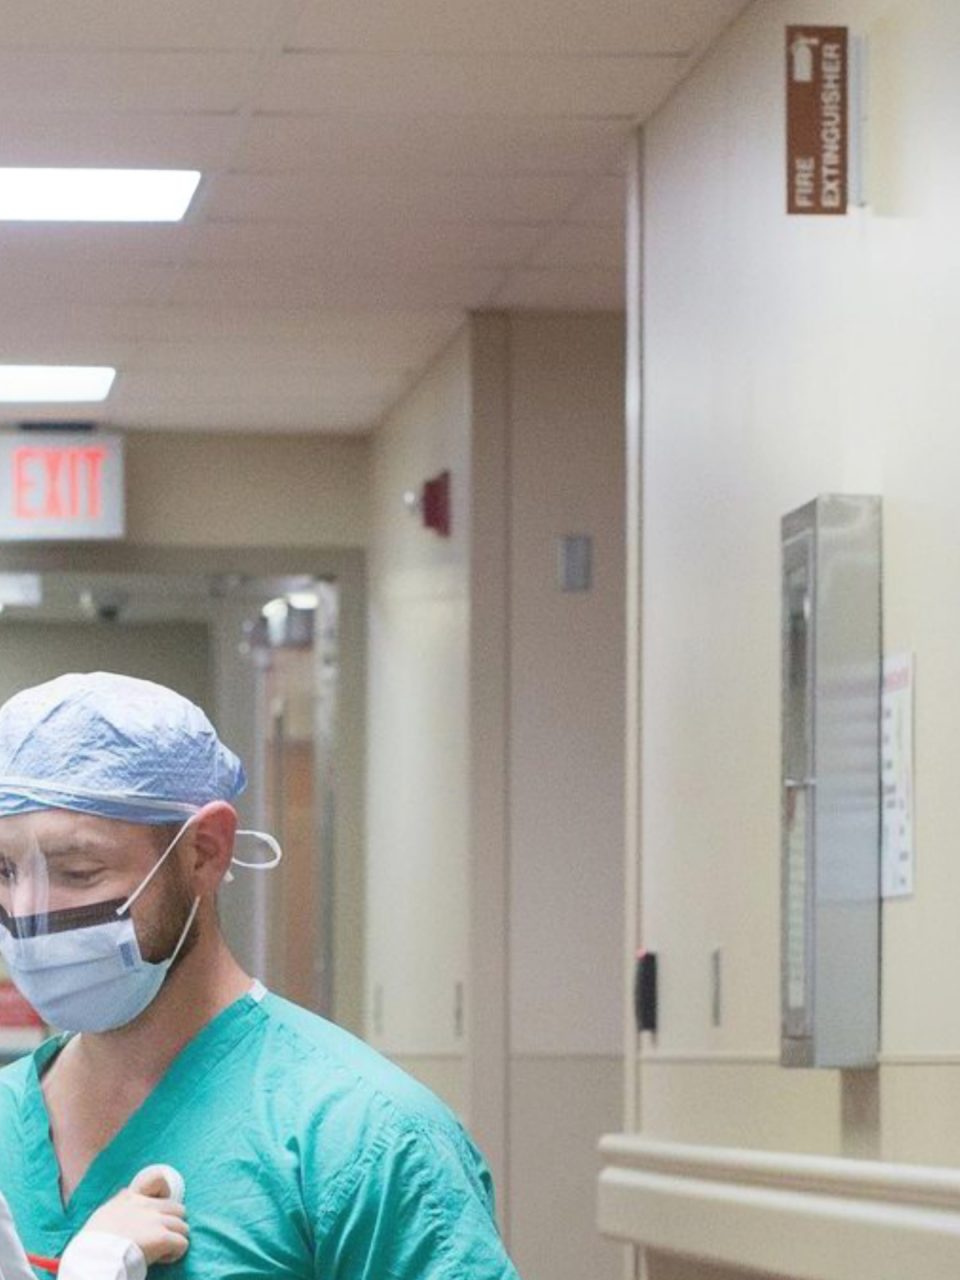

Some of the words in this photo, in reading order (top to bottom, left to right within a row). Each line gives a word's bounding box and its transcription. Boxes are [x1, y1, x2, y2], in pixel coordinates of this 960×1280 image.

[820, 43, 841, 208] EXTINGUISHER
[795, 156, 815, 207] FIRE
[10, 444, 107, 520] EXIT
